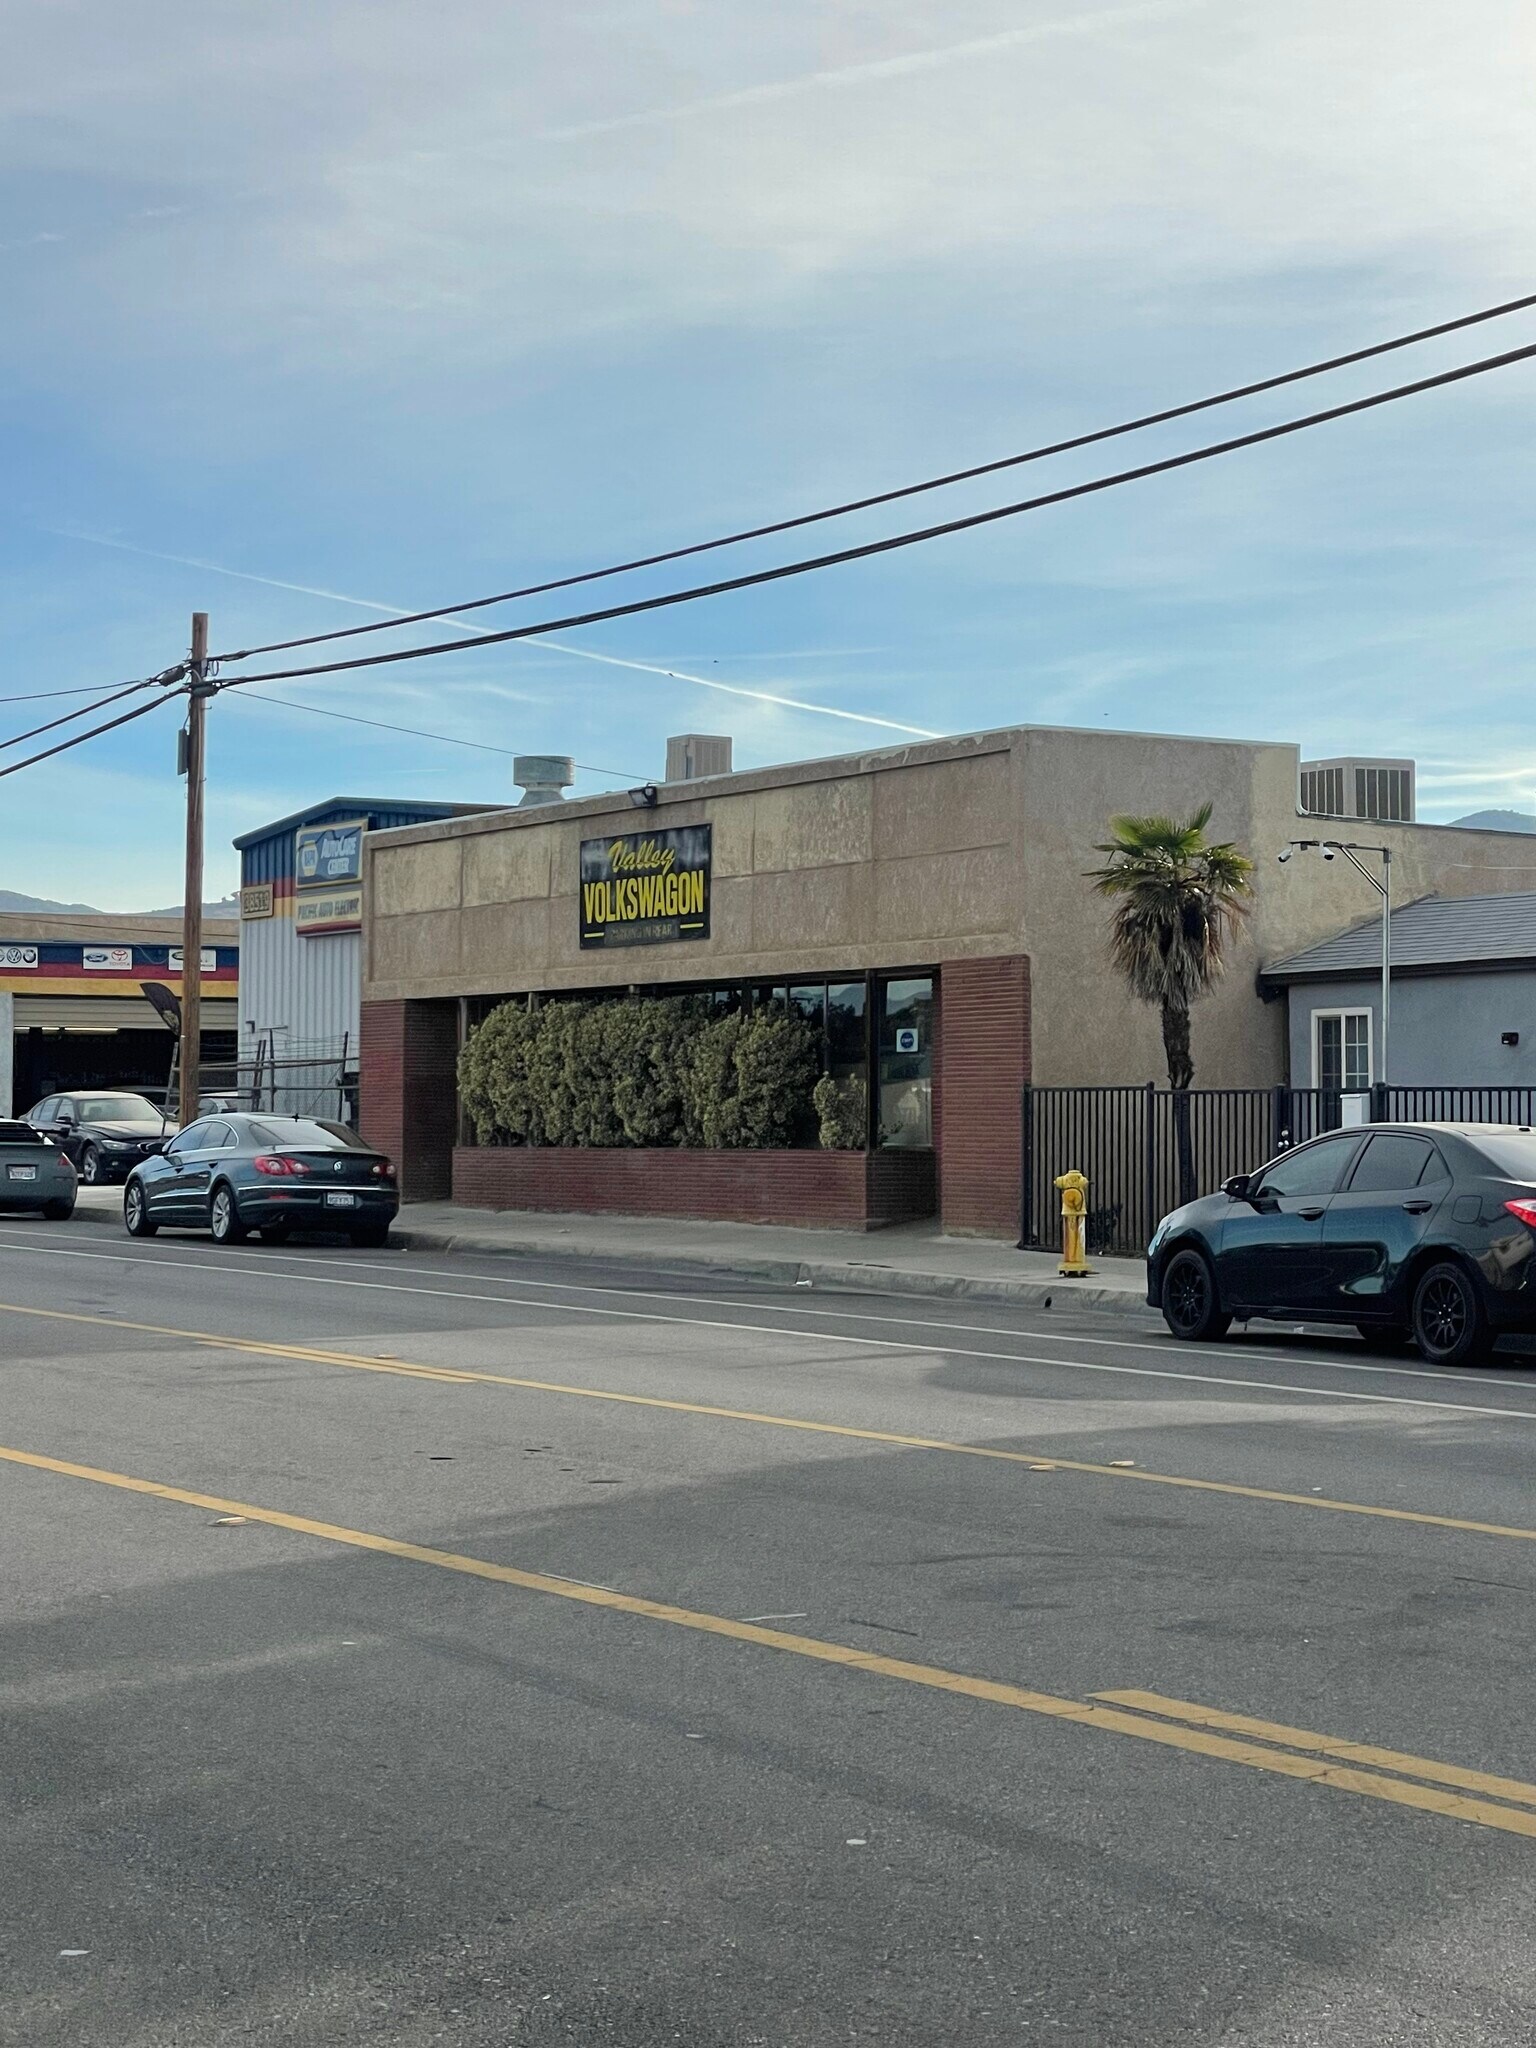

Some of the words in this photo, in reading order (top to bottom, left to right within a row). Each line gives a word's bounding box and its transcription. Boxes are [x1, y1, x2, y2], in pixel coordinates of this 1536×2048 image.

[608, 838, 675, 875] Valley
[318, 901, 333, 917] AUTO
[584, 870, 704, 924] VOLKSWAGON
